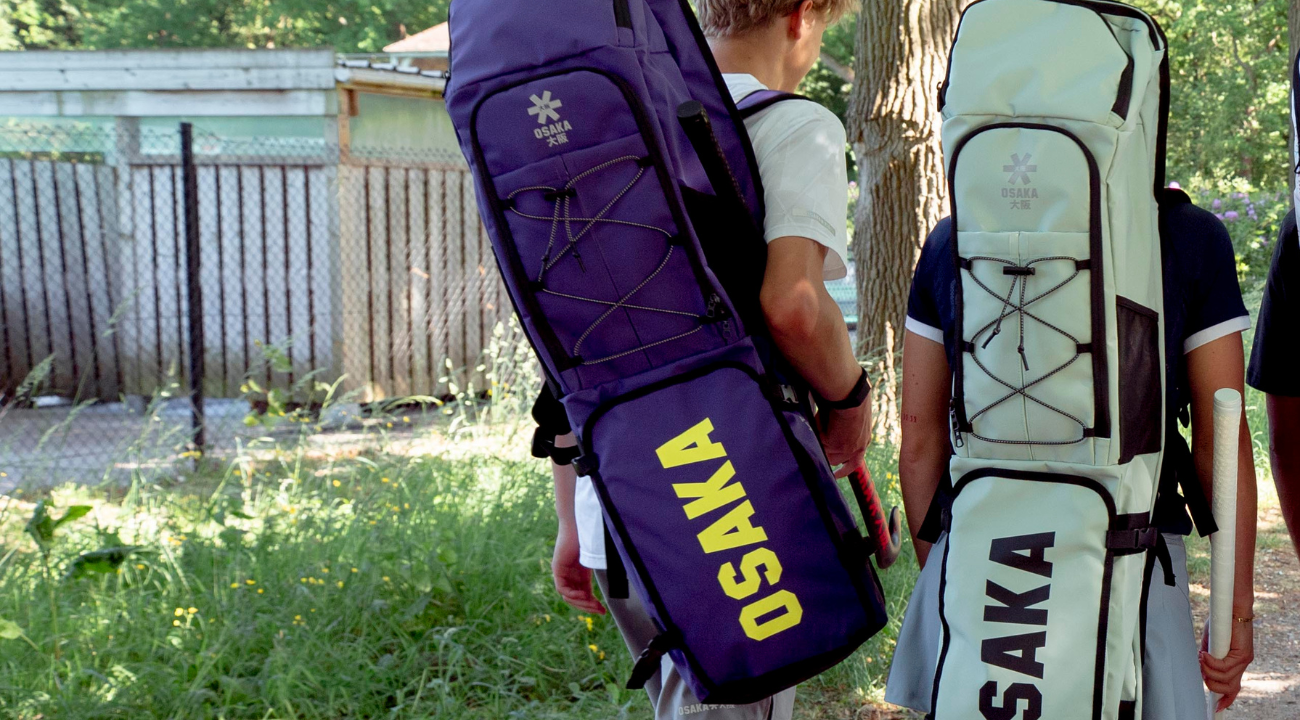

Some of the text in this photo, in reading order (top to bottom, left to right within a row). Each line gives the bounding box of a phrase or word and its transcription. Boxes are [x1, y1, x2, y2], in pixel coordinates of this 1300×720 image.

[533, 120, 573, 139] OSAKA
[546, 132, 569, 147] 大阪
[1001, 187, 1039, 198] OSAKA
[1009, 199, 1031, 210] 大阪
[655, 416, 803, 642] OSAKA
[978, 531, 1056, 720] SAKA
[678, 703, 710, 716] OSAKA
